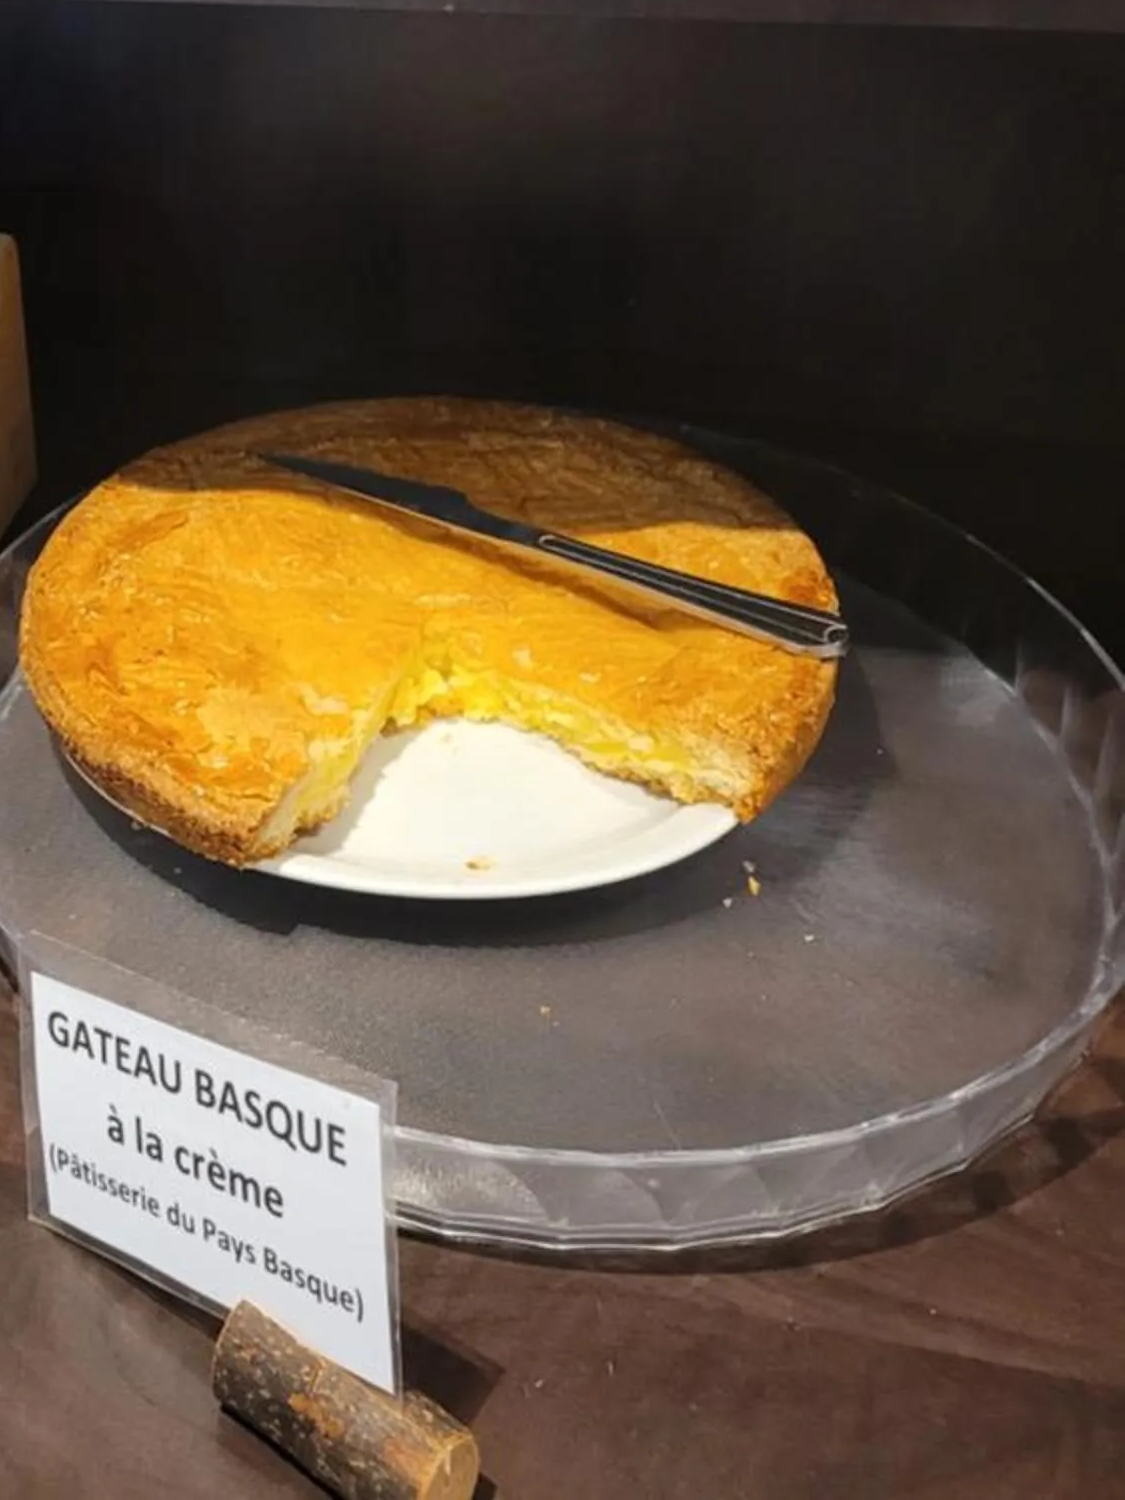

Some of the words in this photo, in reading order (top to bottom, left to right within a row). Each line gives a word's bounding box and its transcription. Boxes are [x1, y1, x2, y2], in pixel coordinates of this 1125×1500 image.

[47, 1011, 182, 1094] GATEAU
[194, 1069, 348, 1166] BASQUE
[107, 1104, 125, 1145] à
[135, 1116, 163, 1163] la
[174, 1148, 285, 1218] crème
[49, 1143, 161, 1218] (Pâtisserie
[166, 1203, 196, 1235] du
[202, 1218, 257, 1265] Pays
[263, 1247, 365, 1324] Basque)
